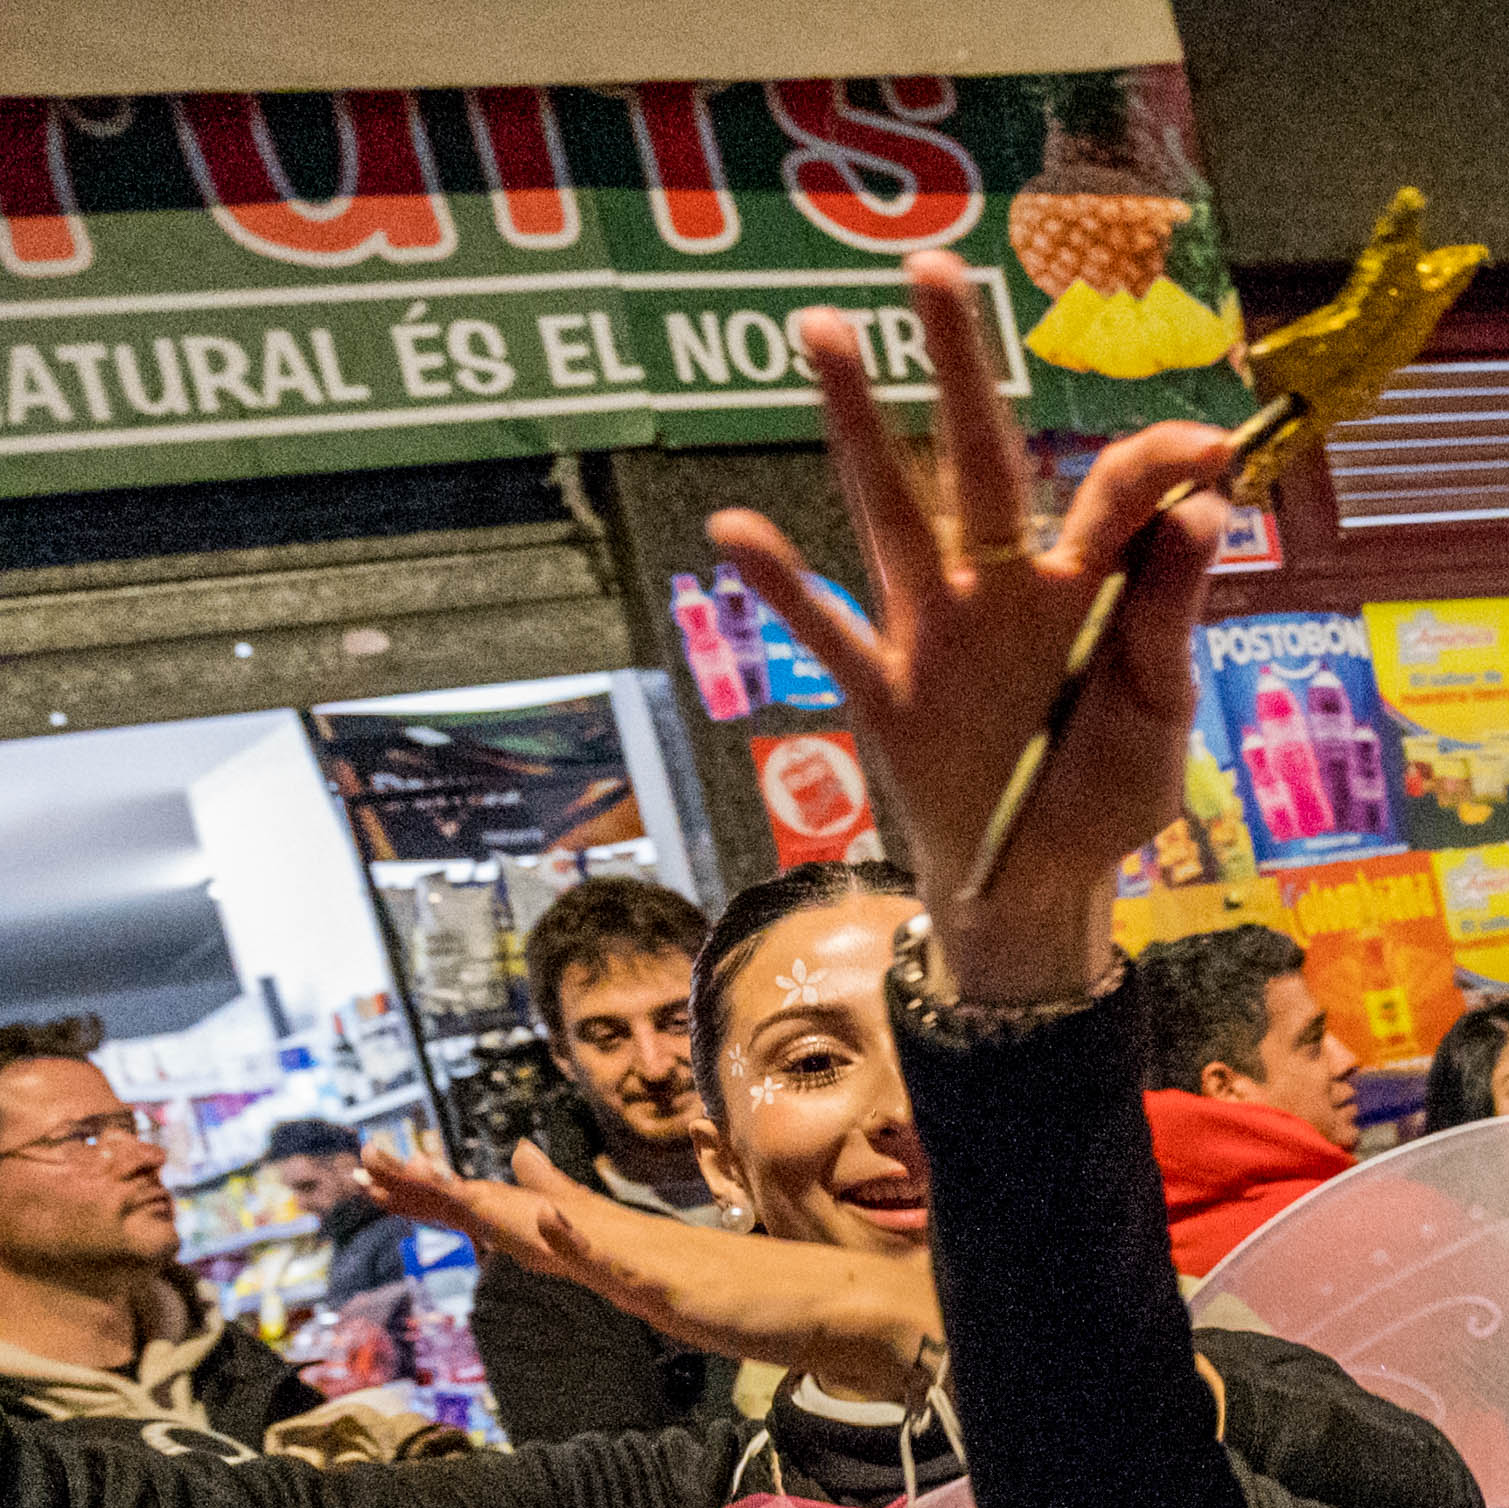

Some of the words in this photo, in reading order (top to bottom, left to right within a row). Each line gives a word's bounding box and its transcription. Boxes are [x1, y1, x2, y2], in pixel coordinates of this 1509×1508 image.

[0, 327, 371, 424] ATURAL
[391, 301, 515, 398] ÉS
[537, 311, 646, 387] EL
[664, 305, 938, 384] NOSTR
